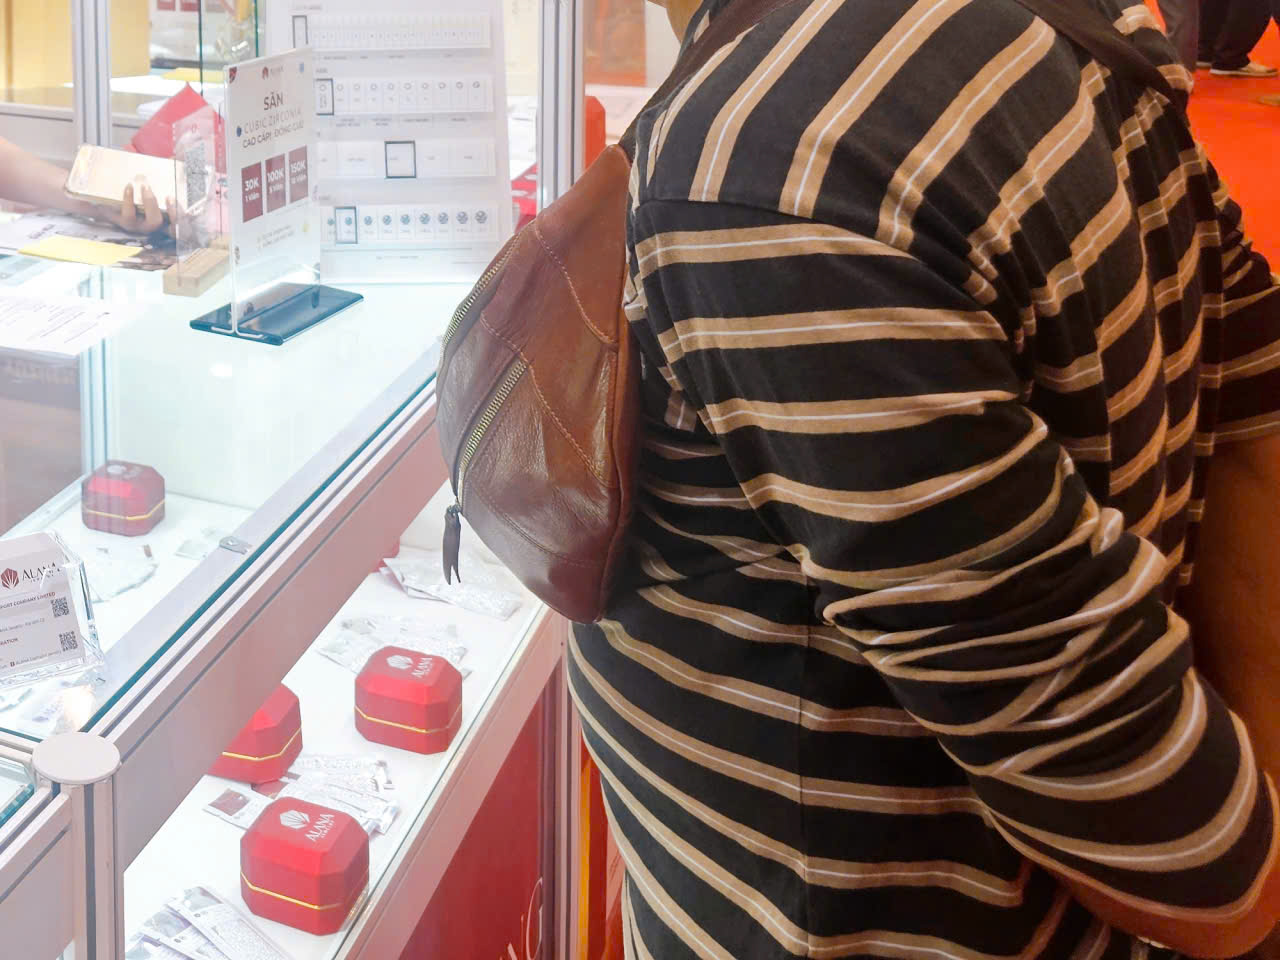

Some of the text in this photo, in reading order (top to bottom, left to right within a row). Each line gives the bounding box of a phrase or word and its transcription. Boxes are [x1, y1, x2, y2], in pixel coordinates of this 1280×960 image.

[267, 168, 284, 183] 100K
[244, 177, 259, 192] 30K
[304, 813, 335, 842] ALANA
